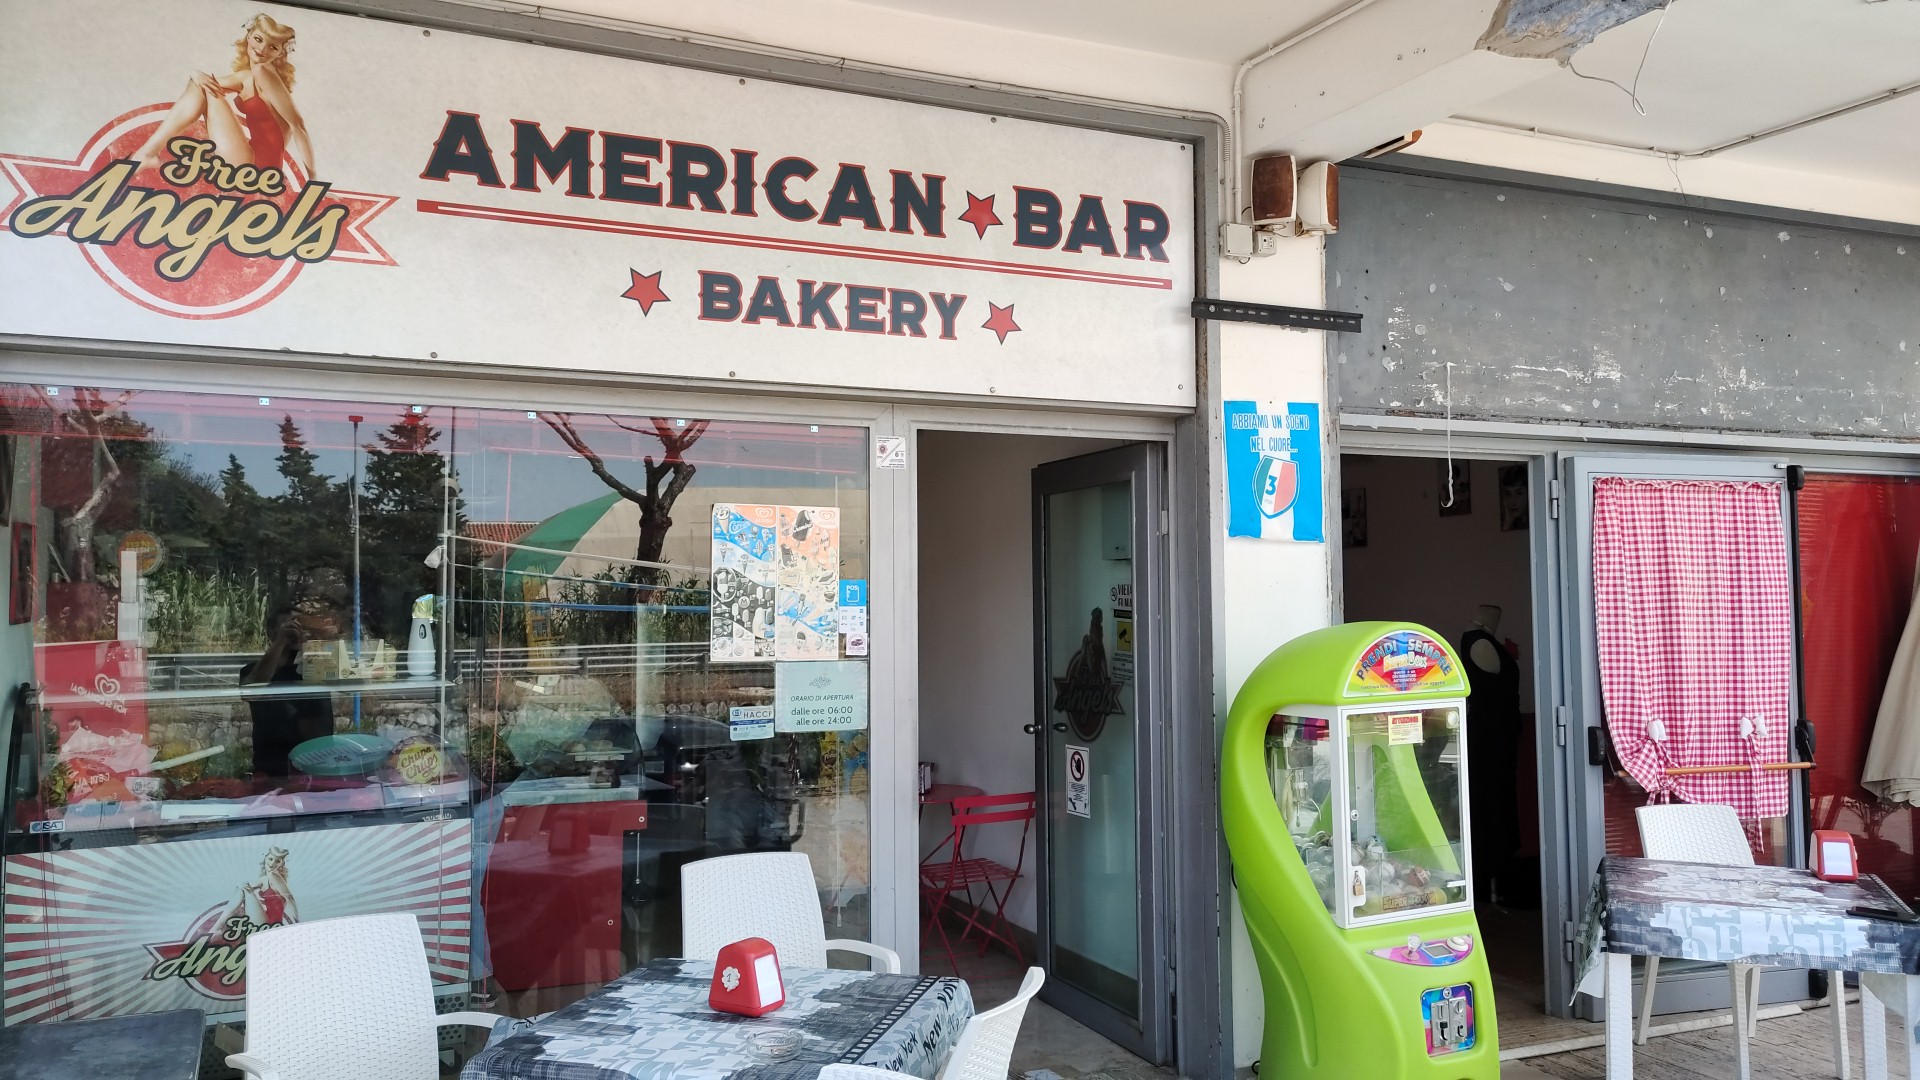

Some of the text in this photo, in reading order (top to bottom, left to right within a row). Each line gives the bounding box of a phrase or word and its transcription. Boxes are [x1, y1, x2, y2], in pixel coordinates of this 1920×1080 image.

[160, 136, 286, 196] Free
[419, 110, 1171, 263] AMERICAN BAR
[9, 159, 349, 282] Angels
[697, 269, 967, 341] BAKERY
[1232, 413, 1310, 431] ABBIAMO UN SOGNO
[1250, 436, 1265, 452] NEL
[1265, 474, 1278, 496] 3
[1356, 638, 1452, 681] PRENDI SEMPRE
[791, 707, 810, 716] dalle
[827, 706, 853, 715] 06:00
[796, 717, 810, 726] alle
[827, 716, 852, 725] 24:00
[401, 747, 433, 768] Chupa
[406, 753, 438, 778] Chups
[726, 973, 732, 982] 1
